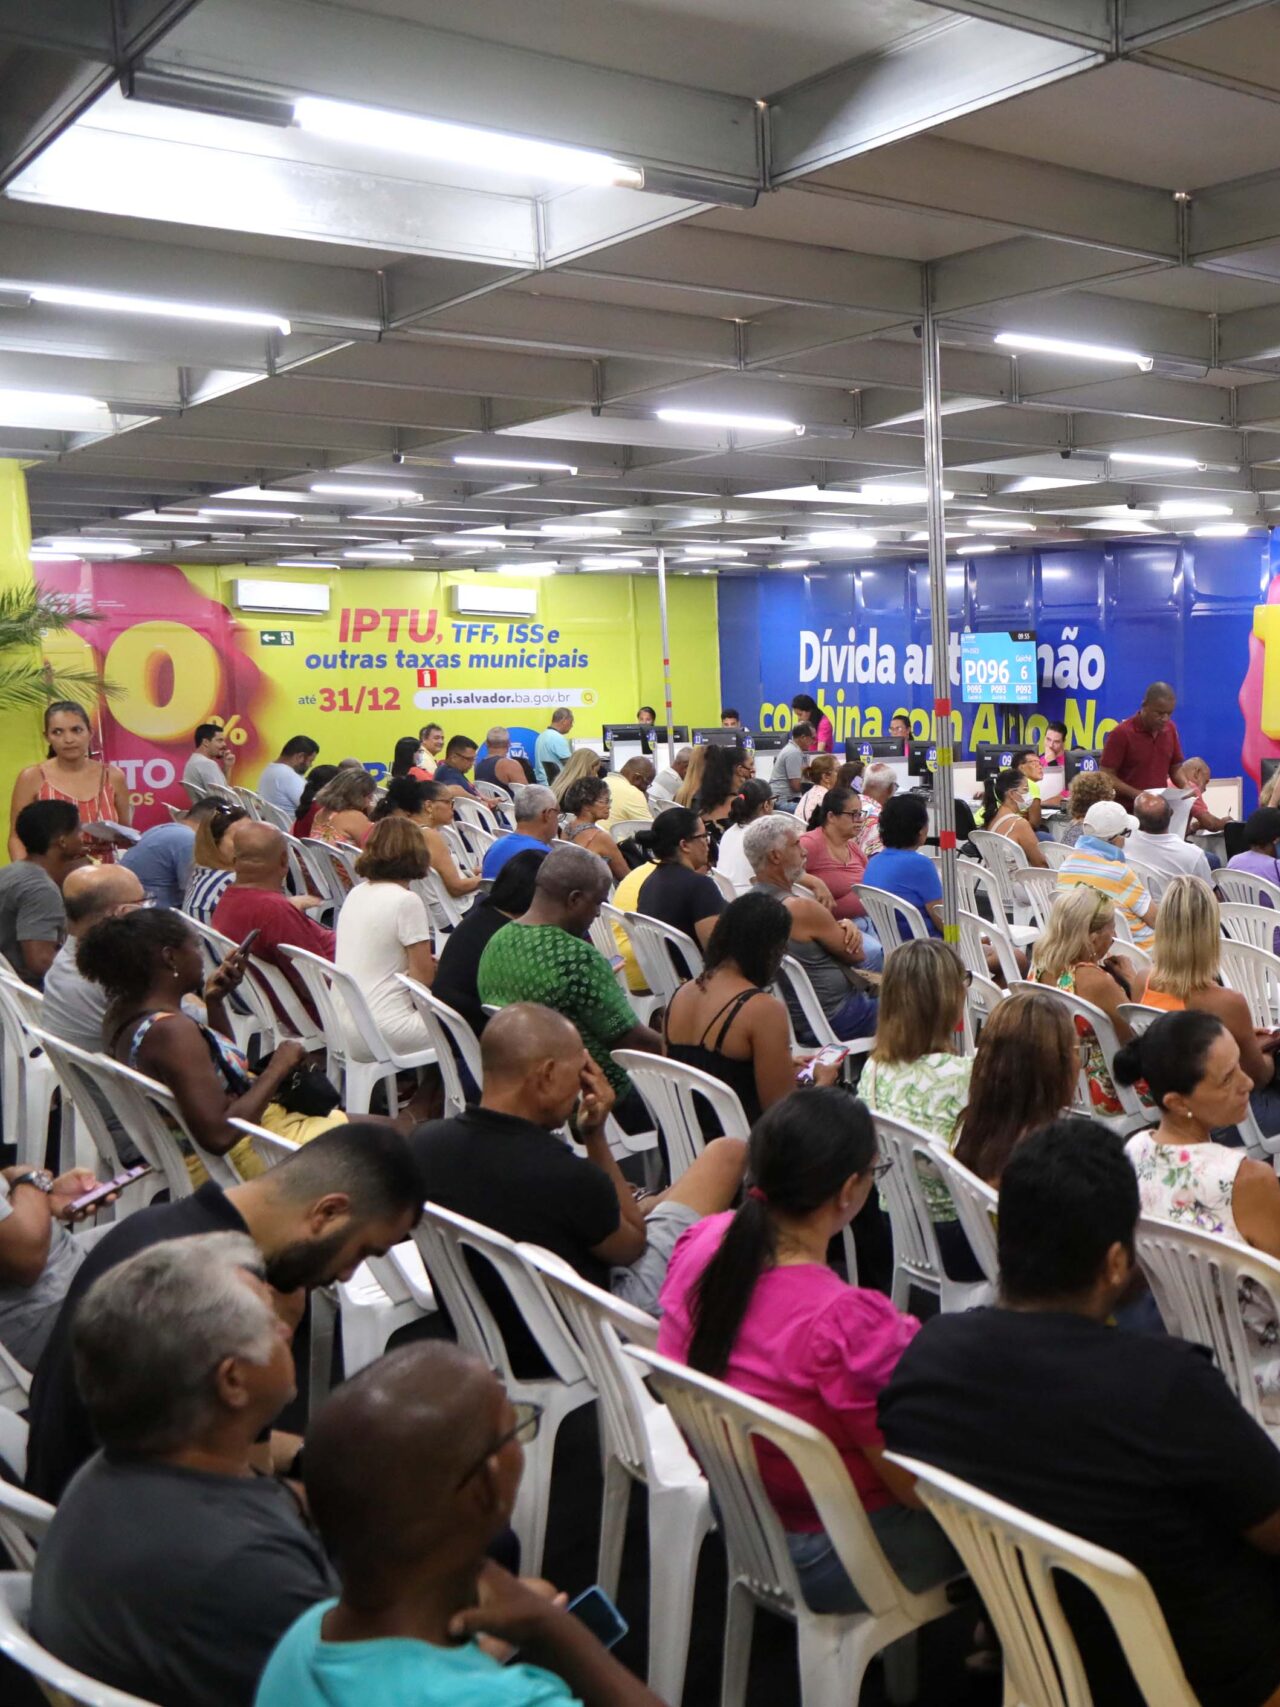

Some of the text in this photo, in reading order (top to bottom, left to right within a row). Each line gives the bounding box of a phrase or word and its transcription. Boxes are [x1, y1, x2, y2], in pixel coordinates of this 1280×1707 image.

[339, 608, 560, 645] IPTU, TFF, ISS e
[305, 648, 589, 673] outras taxas municipais
[799, 627, 896, 684] Dívida
[1037, 626, 1105, 690] não
[965, 660, 1010, 684] P096
[1021, 665, 1028, 680] 6
[298, 686, 401, 714] até 31/12
[431, 692, 570, 707] ppi.salvador.ba.gov.br
[760, 689, 882, 743] cobina
[863, 745, 869, 756] 11
[929, 750, 936, 760] 10
[1002, 756, 1012, 766] 09
[1084, 760, 1093, 771] 08
